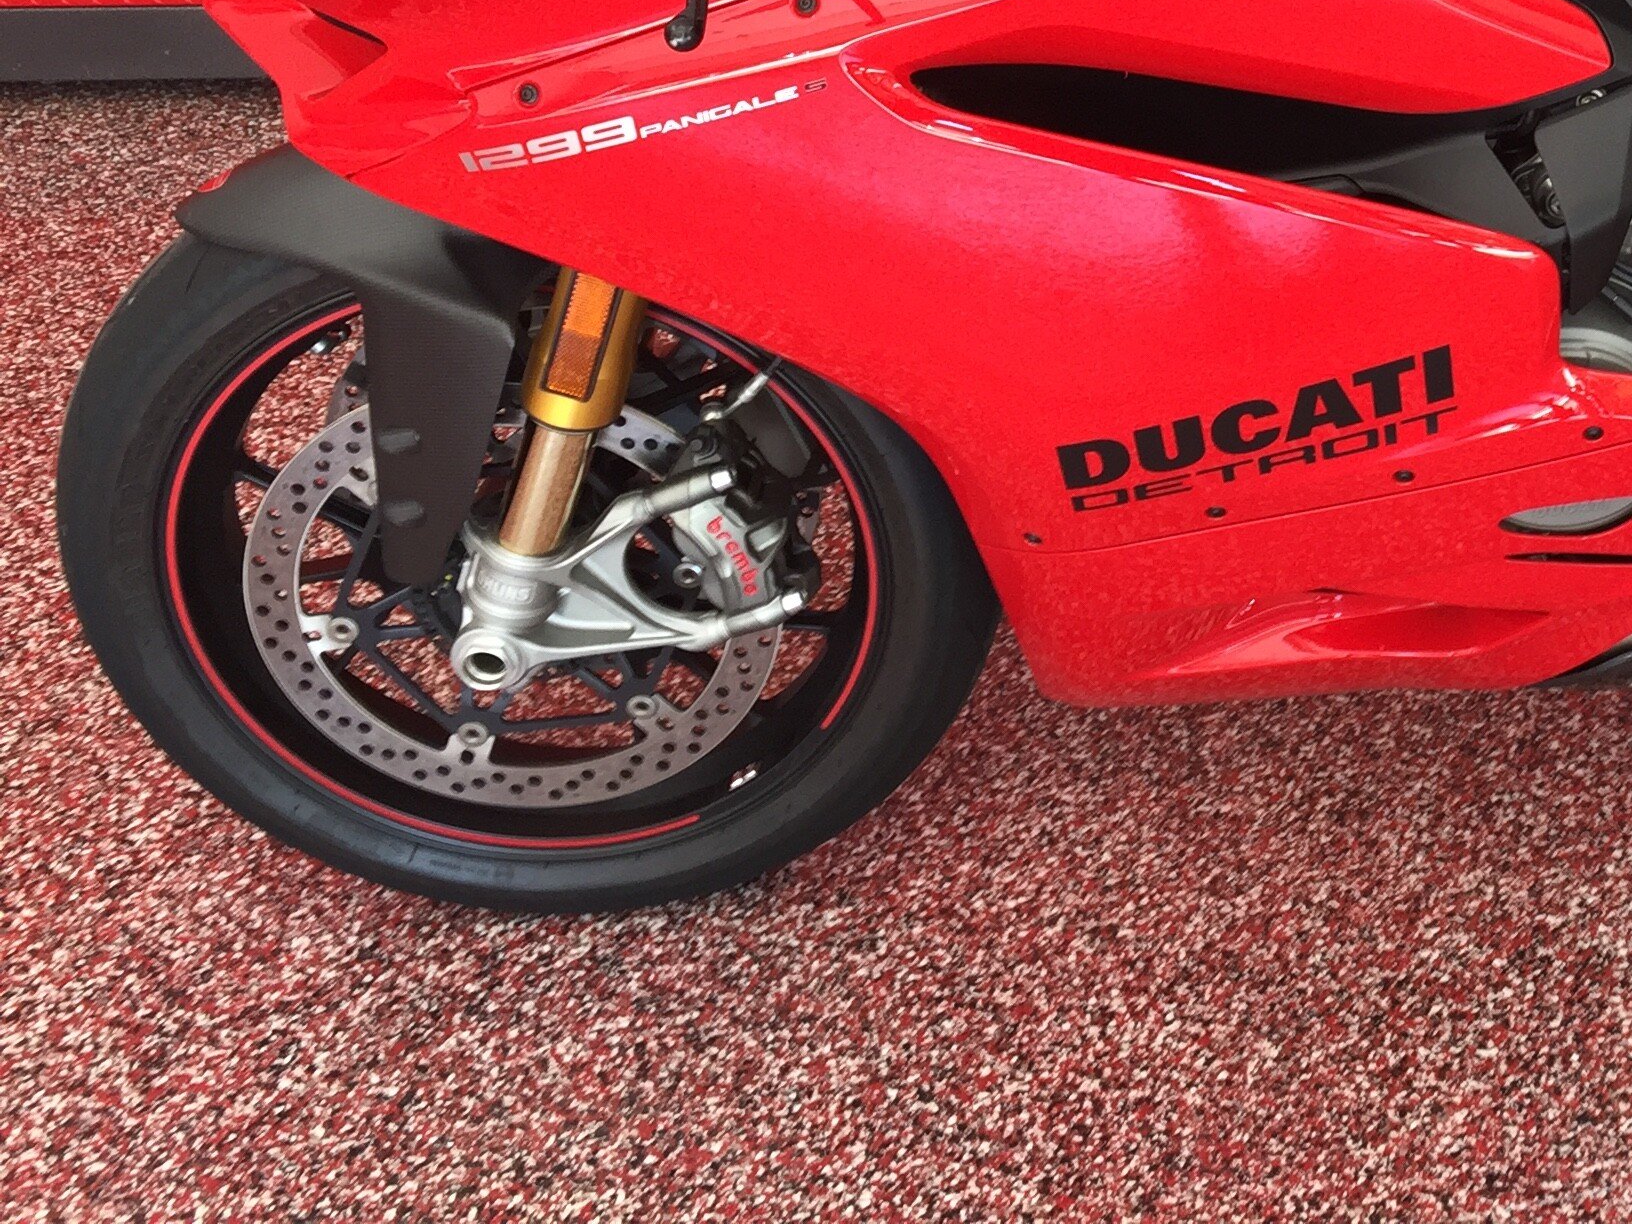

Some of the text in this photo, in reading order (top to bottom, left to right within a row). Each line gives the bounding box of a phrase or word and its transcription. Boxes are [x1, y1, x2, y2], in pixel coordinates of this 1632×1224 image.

[458, 115, 637, 172] 1299
[639, 85, 800, 139] PANIGALE
[1056, 344, 1455, 490] DUCATI
[1071, 405, 1459, 513] DETROIT
[706, 515, 758, 596] brembo
